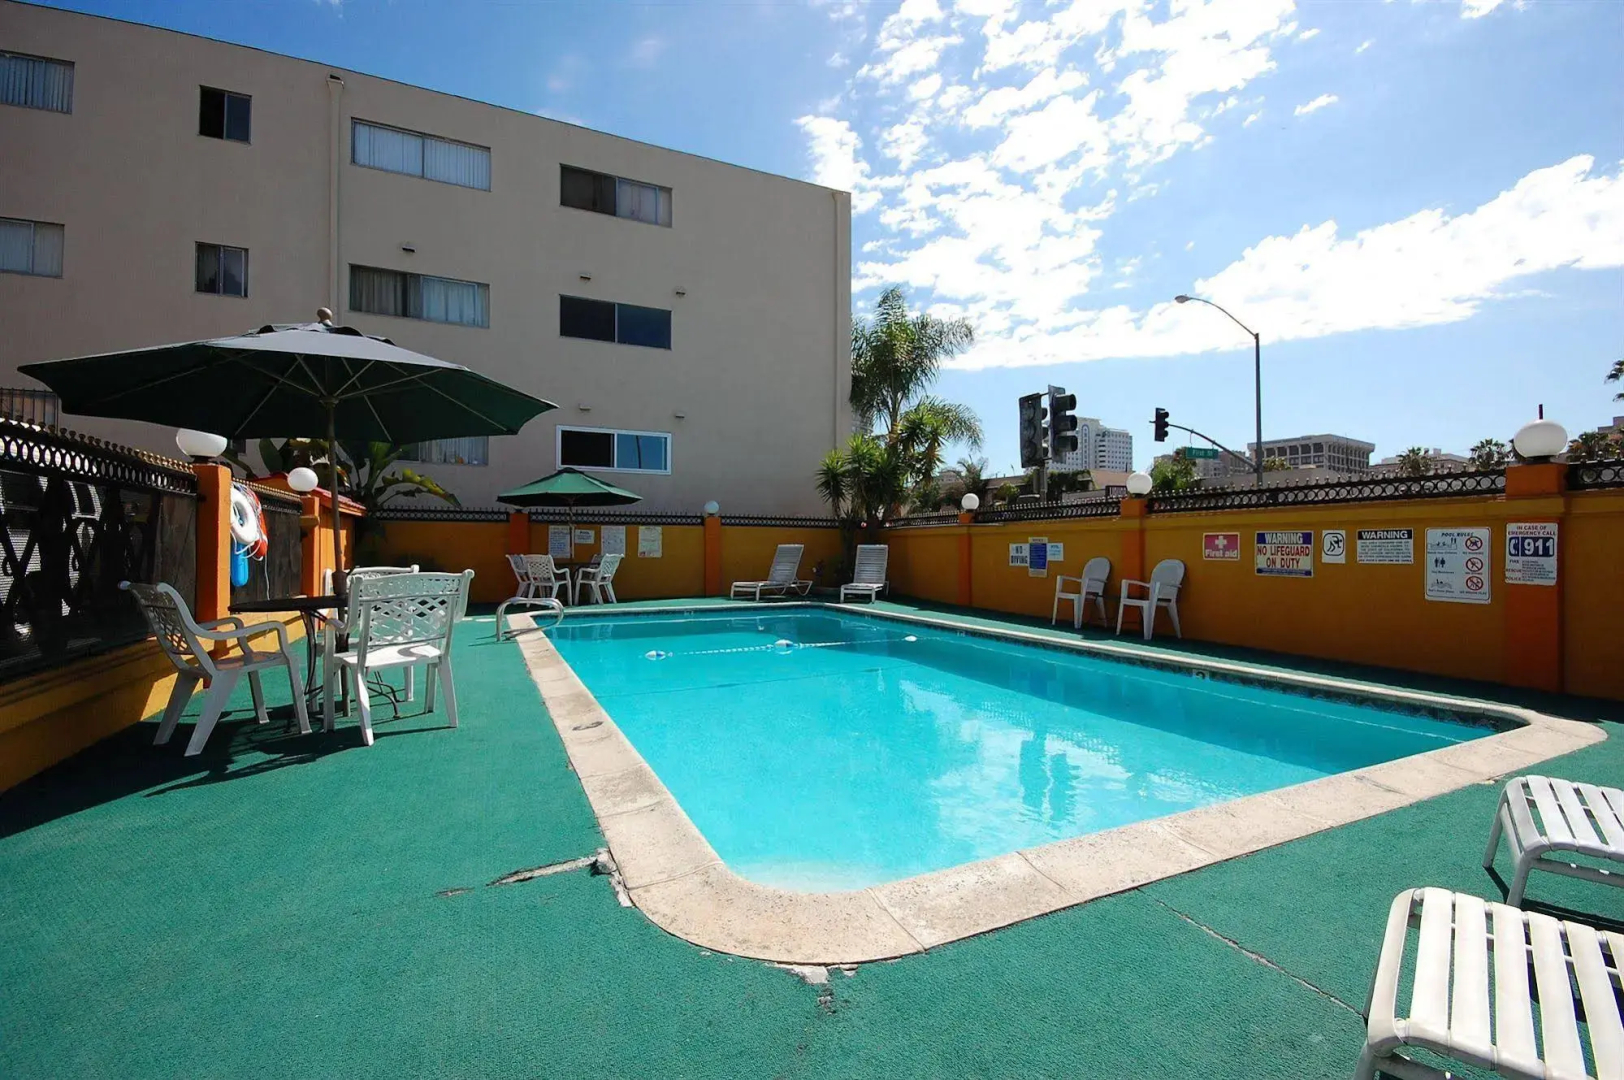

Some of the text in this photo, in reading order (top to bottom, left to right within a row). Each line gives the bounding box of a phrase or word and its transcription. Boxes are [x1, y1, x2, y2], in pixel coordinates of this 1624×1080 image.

[1264, 532, 1303, 544] WARNING
[1015, 546, 1023, 554] NO
[1257, 545, 1310, 556] NO LIFEGUARD
[1524, 538, 1554, 555] 911
[1011, 556, 1028, 564] DIVING
[1266, 557, 1300, 568] ON DUTY
